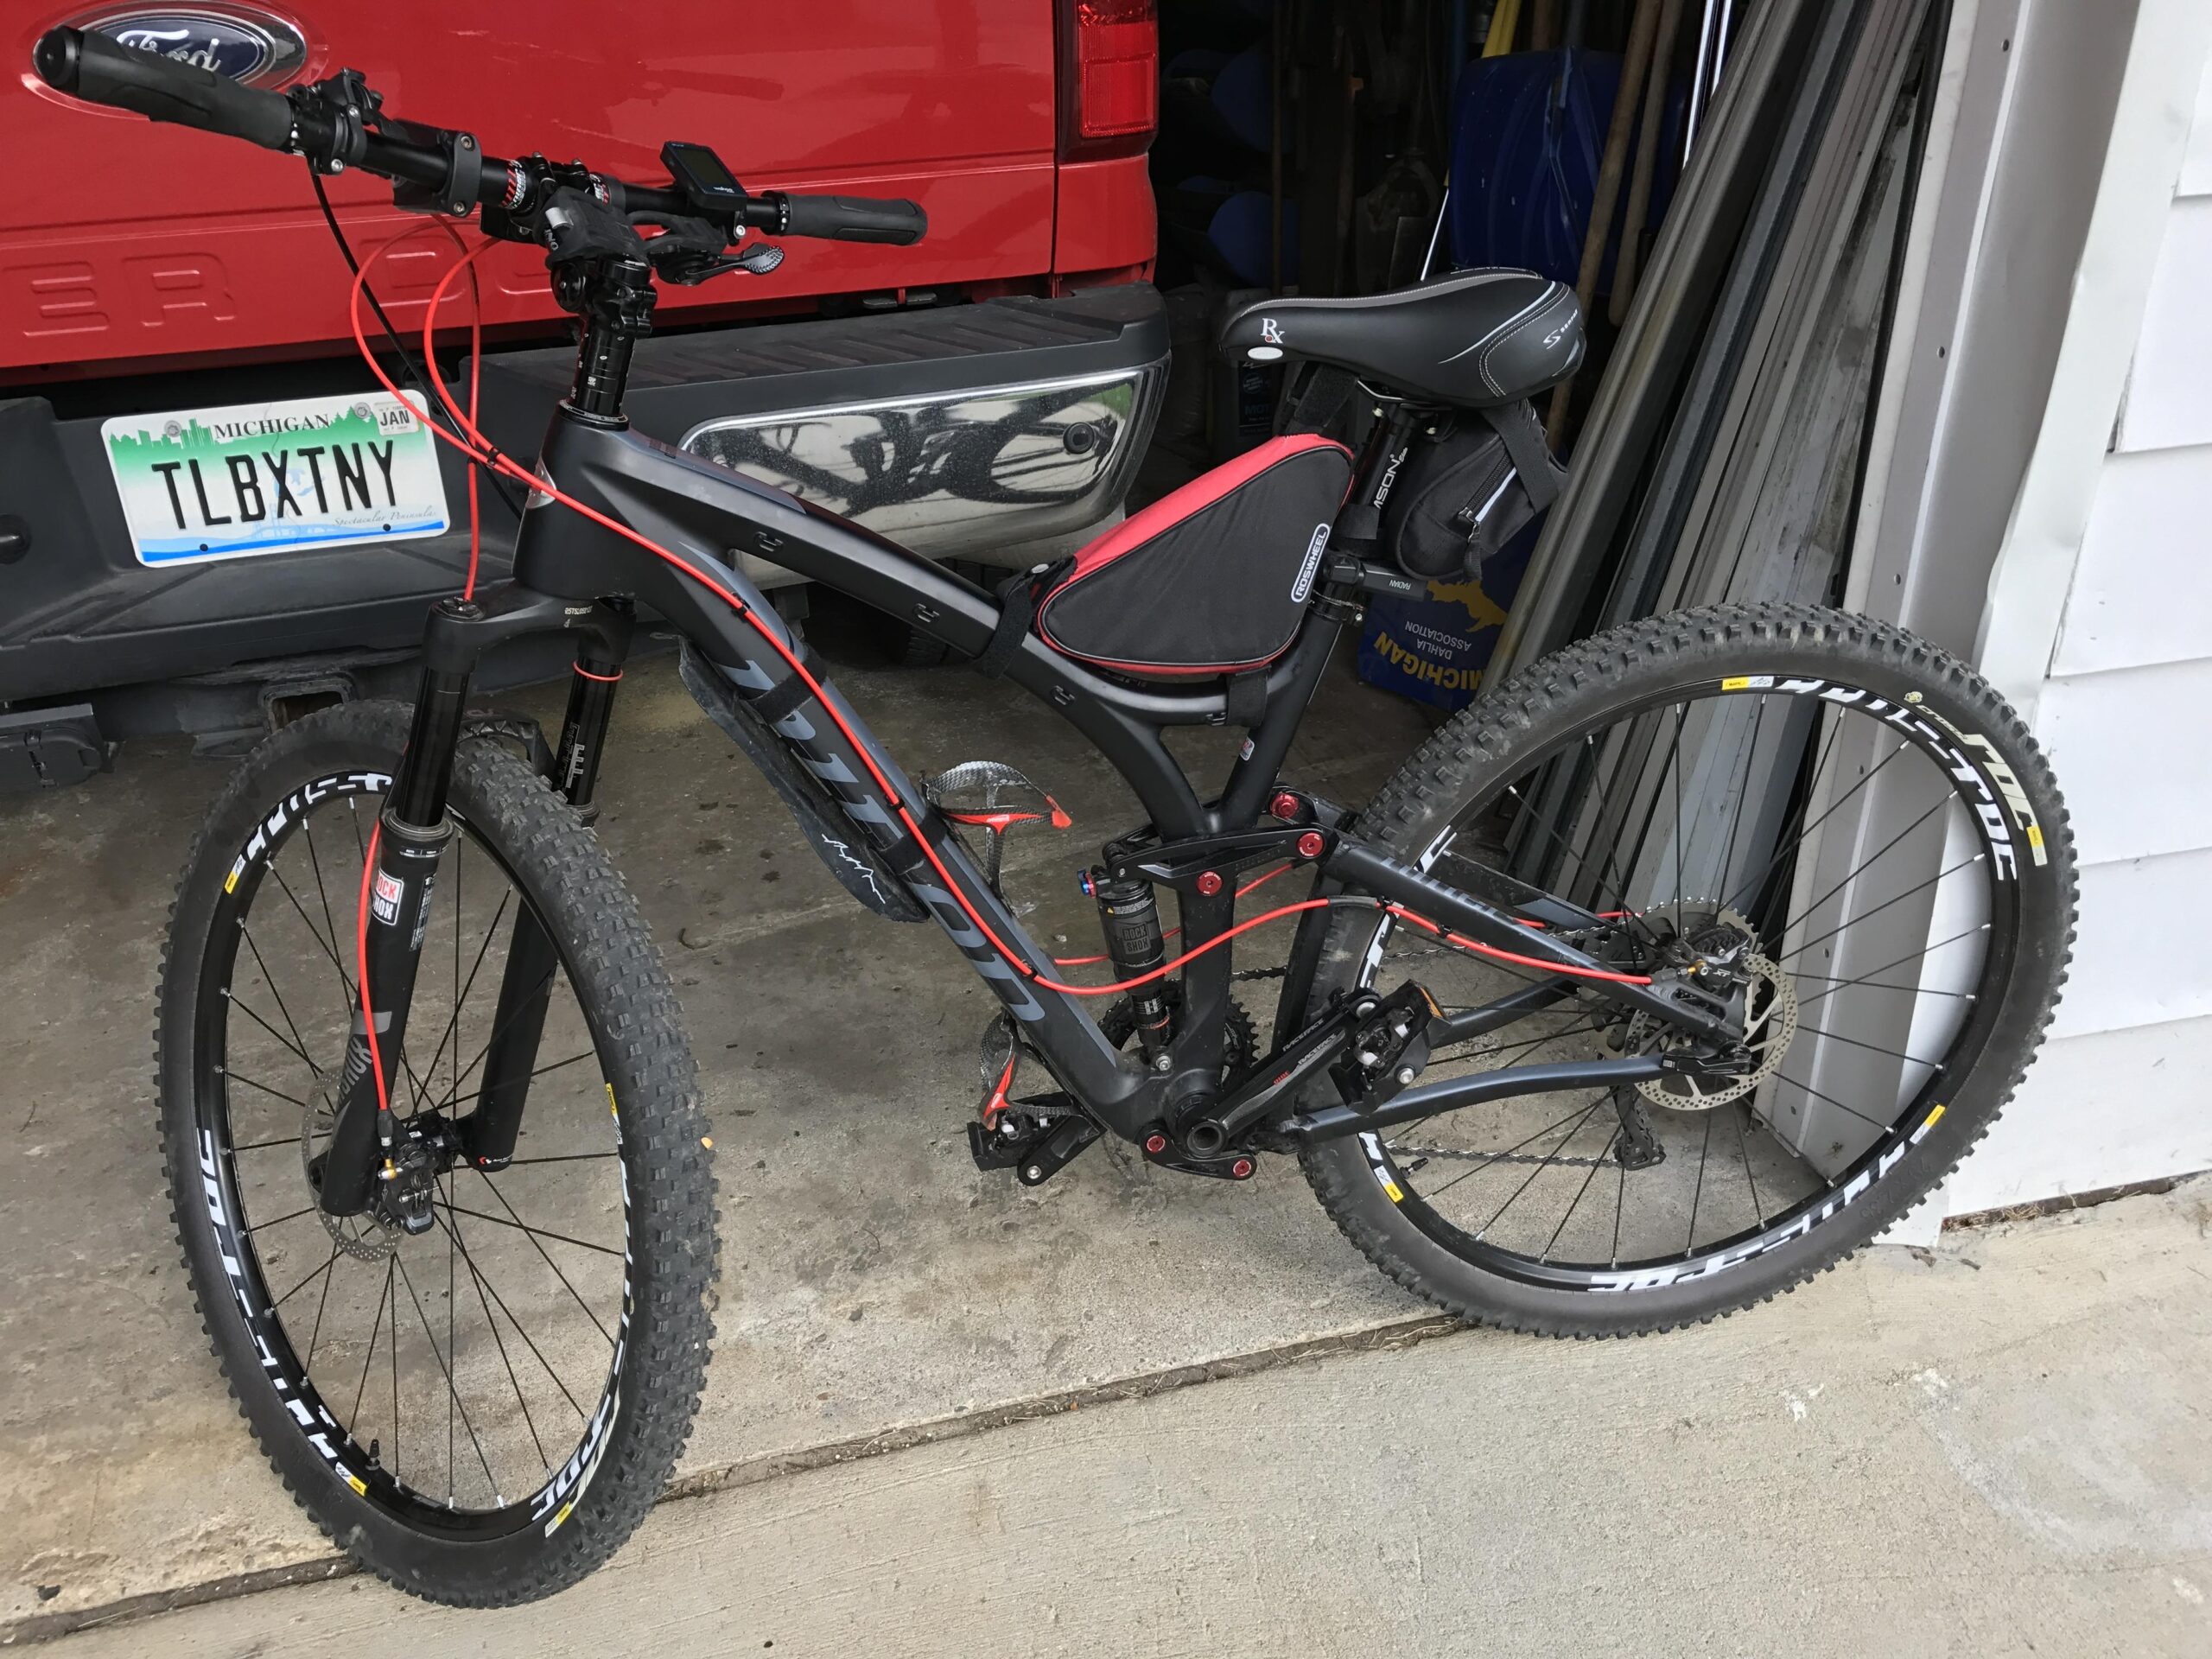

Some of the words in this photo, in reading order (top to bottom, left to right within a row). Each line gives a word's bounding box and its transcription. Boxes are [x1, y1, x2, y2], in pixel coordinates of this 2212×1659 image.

[213, 413, 331, 440] MICHIGAN
[380, 410, 410, 426] JAN
[151, 439, 396, 530] TLBXTNY
[1295, 531, 1327, 597] ROSWHEEL
[1389, 579, 1412, 591] RADIAN
[1404, 620, 1472, 652] ASSOCIATION
[1416, 638, 1452, 660] DAHLIA
[377, 876, 397, 899] OCK
[1124, 923, 1147, 940] ROCK
[1126, 940, 1149, 952] SHOX
